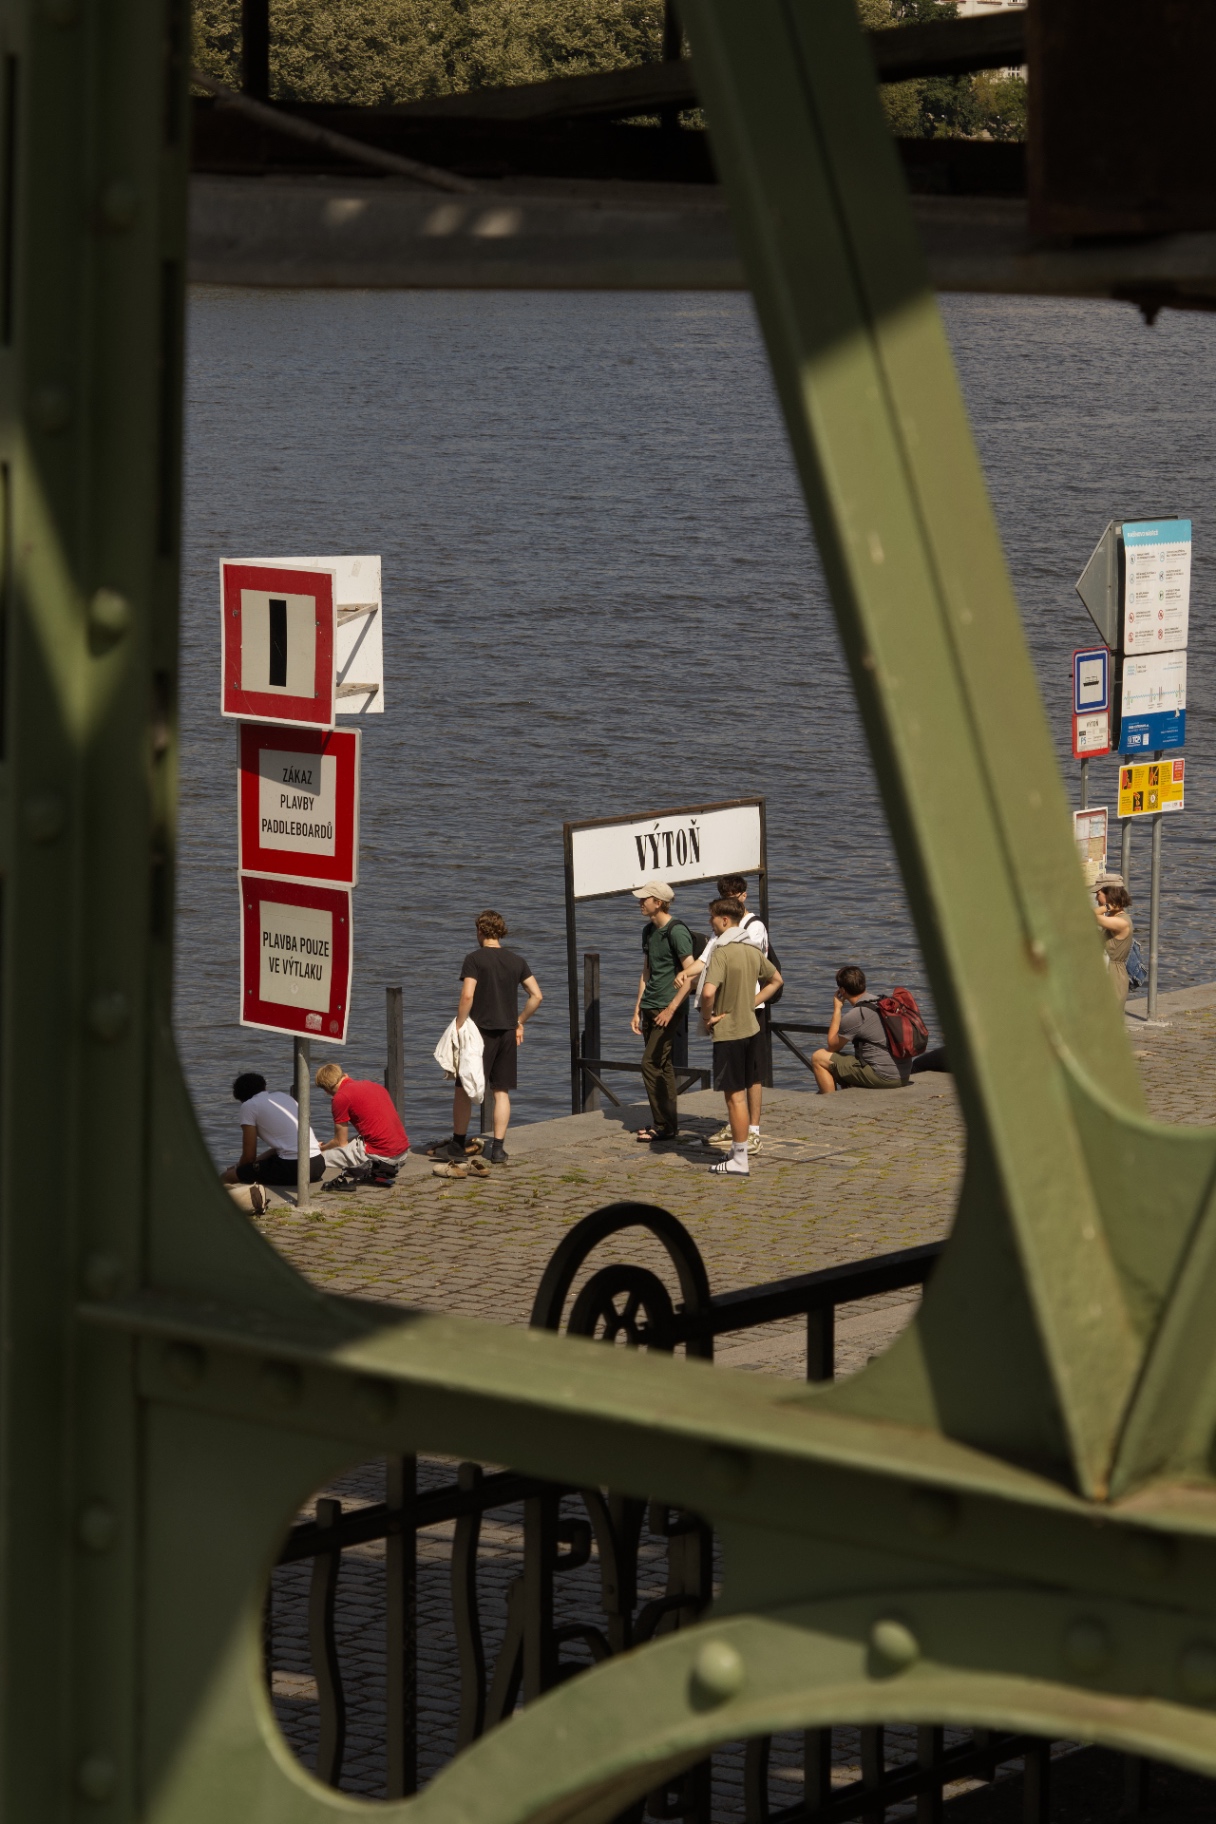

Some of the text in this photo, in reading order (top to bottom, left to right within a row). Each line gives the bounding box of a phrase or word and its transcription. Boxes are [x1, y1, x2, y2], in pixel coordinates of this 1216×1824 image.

[282, 766, 312, 785] ZÁKAZ
[280, 794, 315, 811] PLAVBY
[261, 818, 333, 840] PADDLEBOARDŮ
[634, 818, 700, 871] VÝTOŇ
[262, 931, 330, 957] PLAVBA POUZE
[268, 956, 323, 981] VE VÝTLAKU
